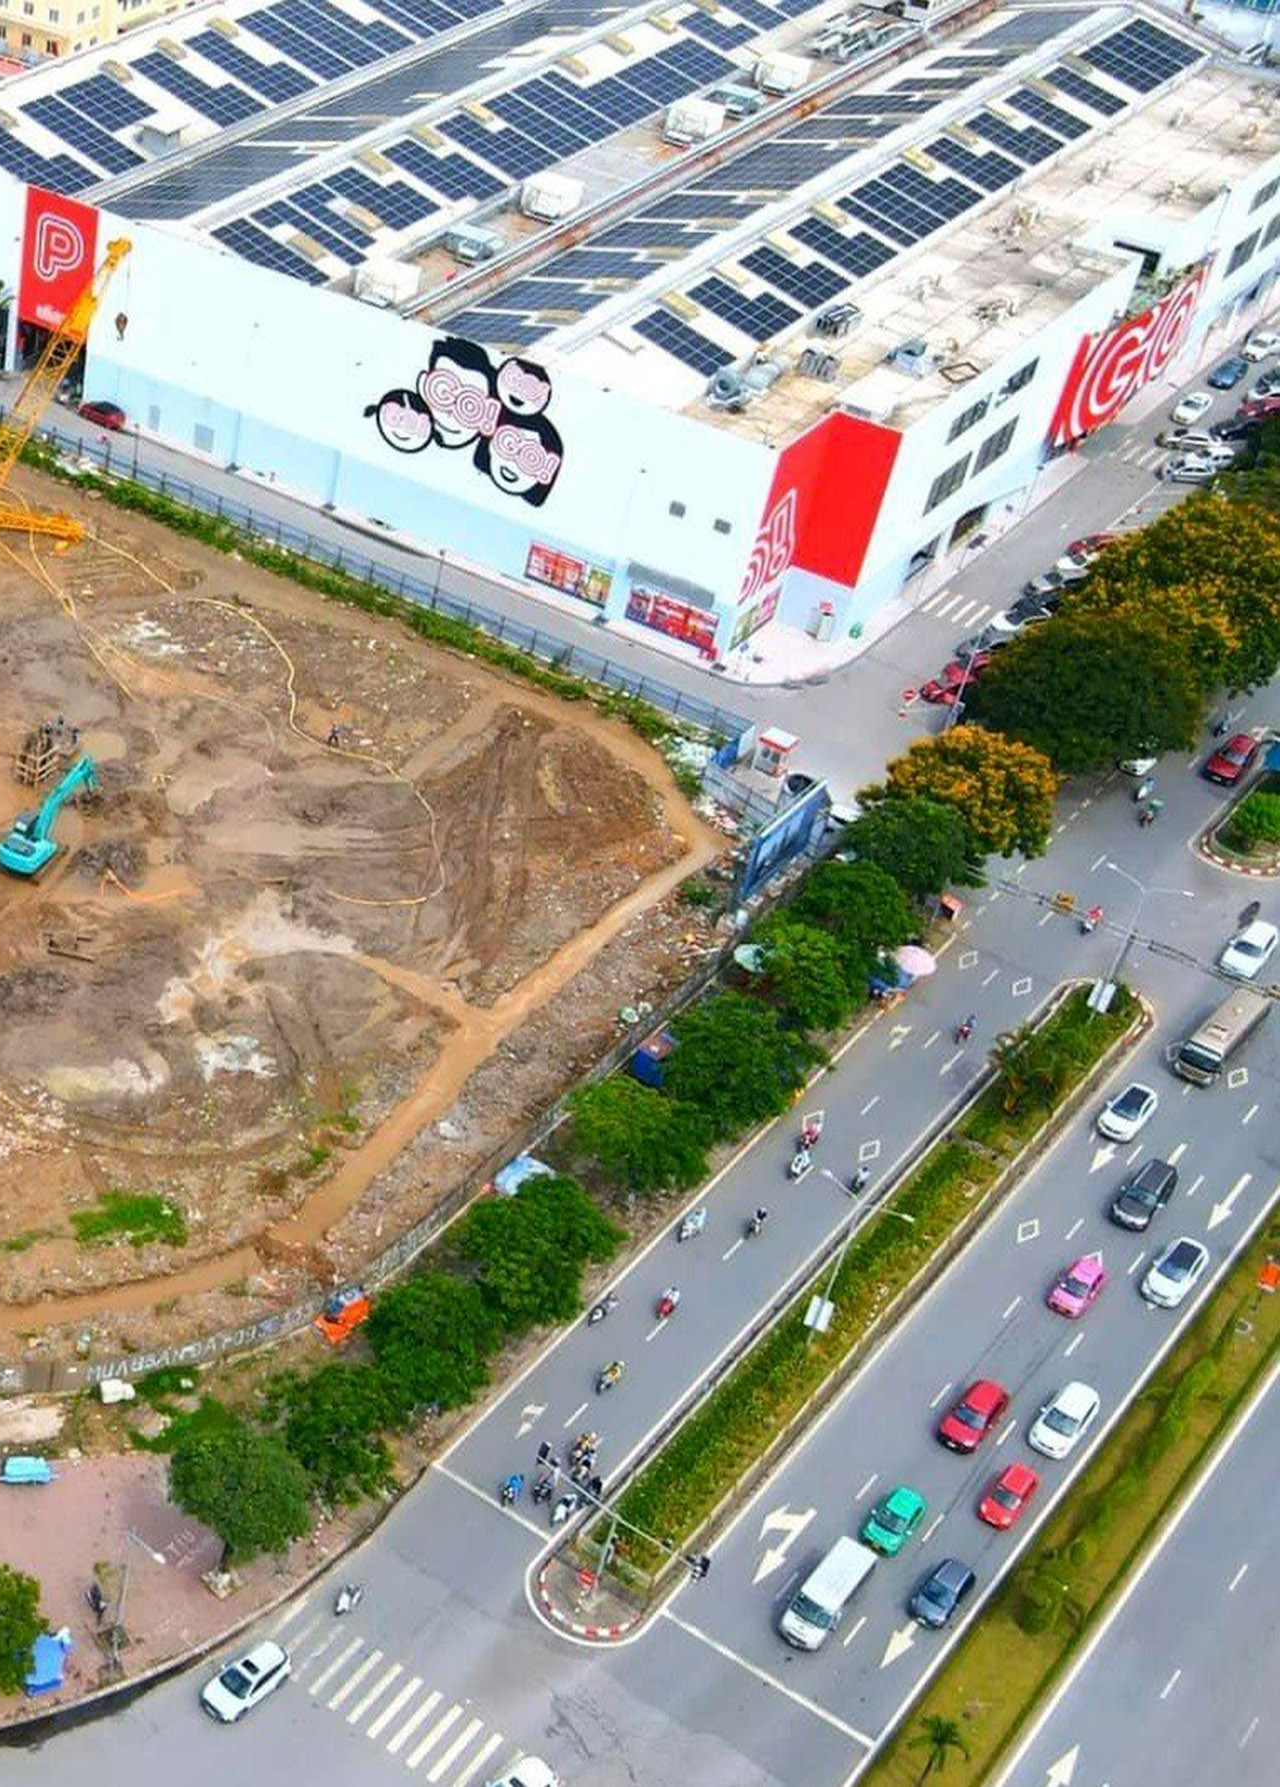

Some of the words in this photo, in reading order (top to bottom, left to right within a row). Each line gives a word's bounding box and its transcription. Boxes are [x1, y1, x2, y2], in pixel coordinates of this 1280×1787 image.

[34, 212, 84, 281] P
[423, 369, 502, 437] GO!
[492, 424, 560, 484] GO!
